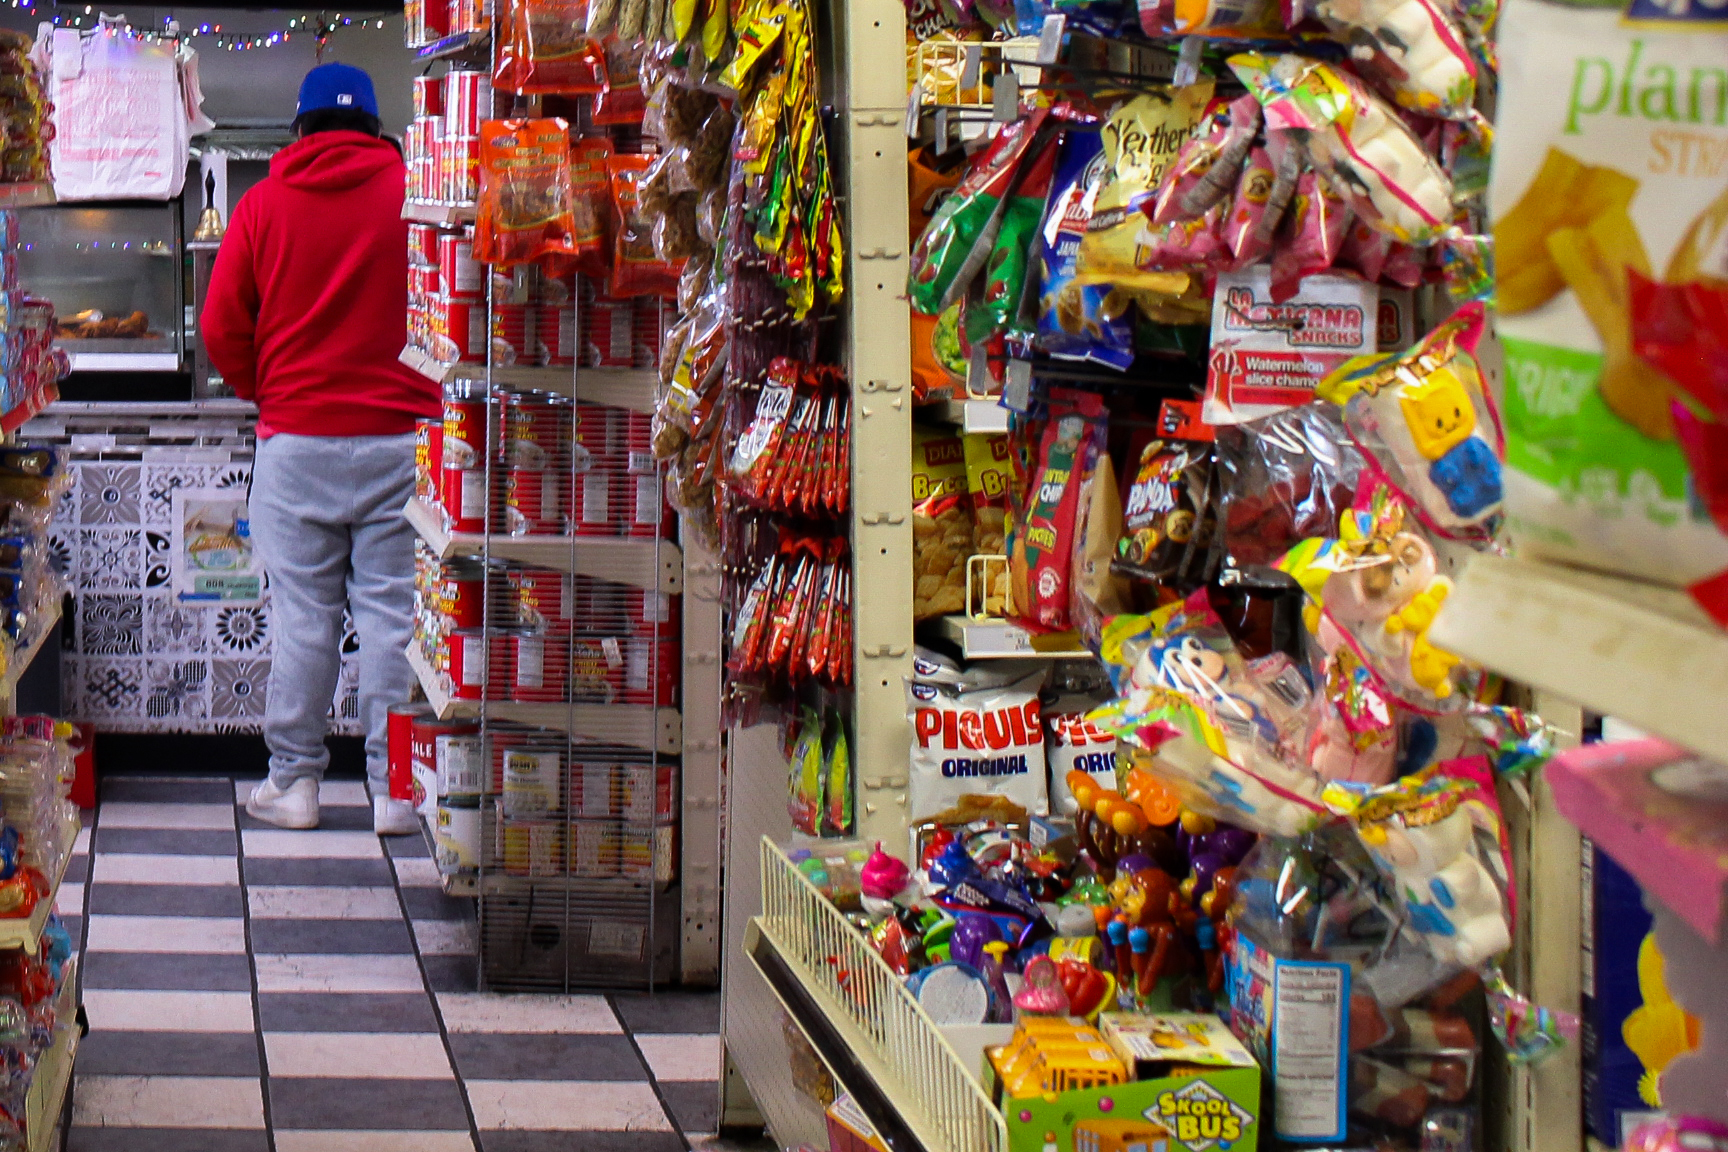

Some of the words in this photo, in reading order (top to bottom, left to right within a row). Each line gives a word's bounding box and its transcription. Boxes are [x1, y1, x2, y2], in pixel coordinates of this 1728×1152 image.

[1229, 290, 1253, 306] LA
[1291, 330, 1361, 345] SNACKS
[1246, 356, 1324, 373] Watermelon
[1245, 373, 1274, 388] slice
[1275, 372, 1320, 389] chamo
[912, 473, 968, 500] Baco
[915, 698, 1044, 751] PIQUIS
[941, 754, 1028, 778] ORIGINAL
[1158, 1091, 1232, 1117] SKOOL
[1176, 1114, 1242, 1141] BUS
